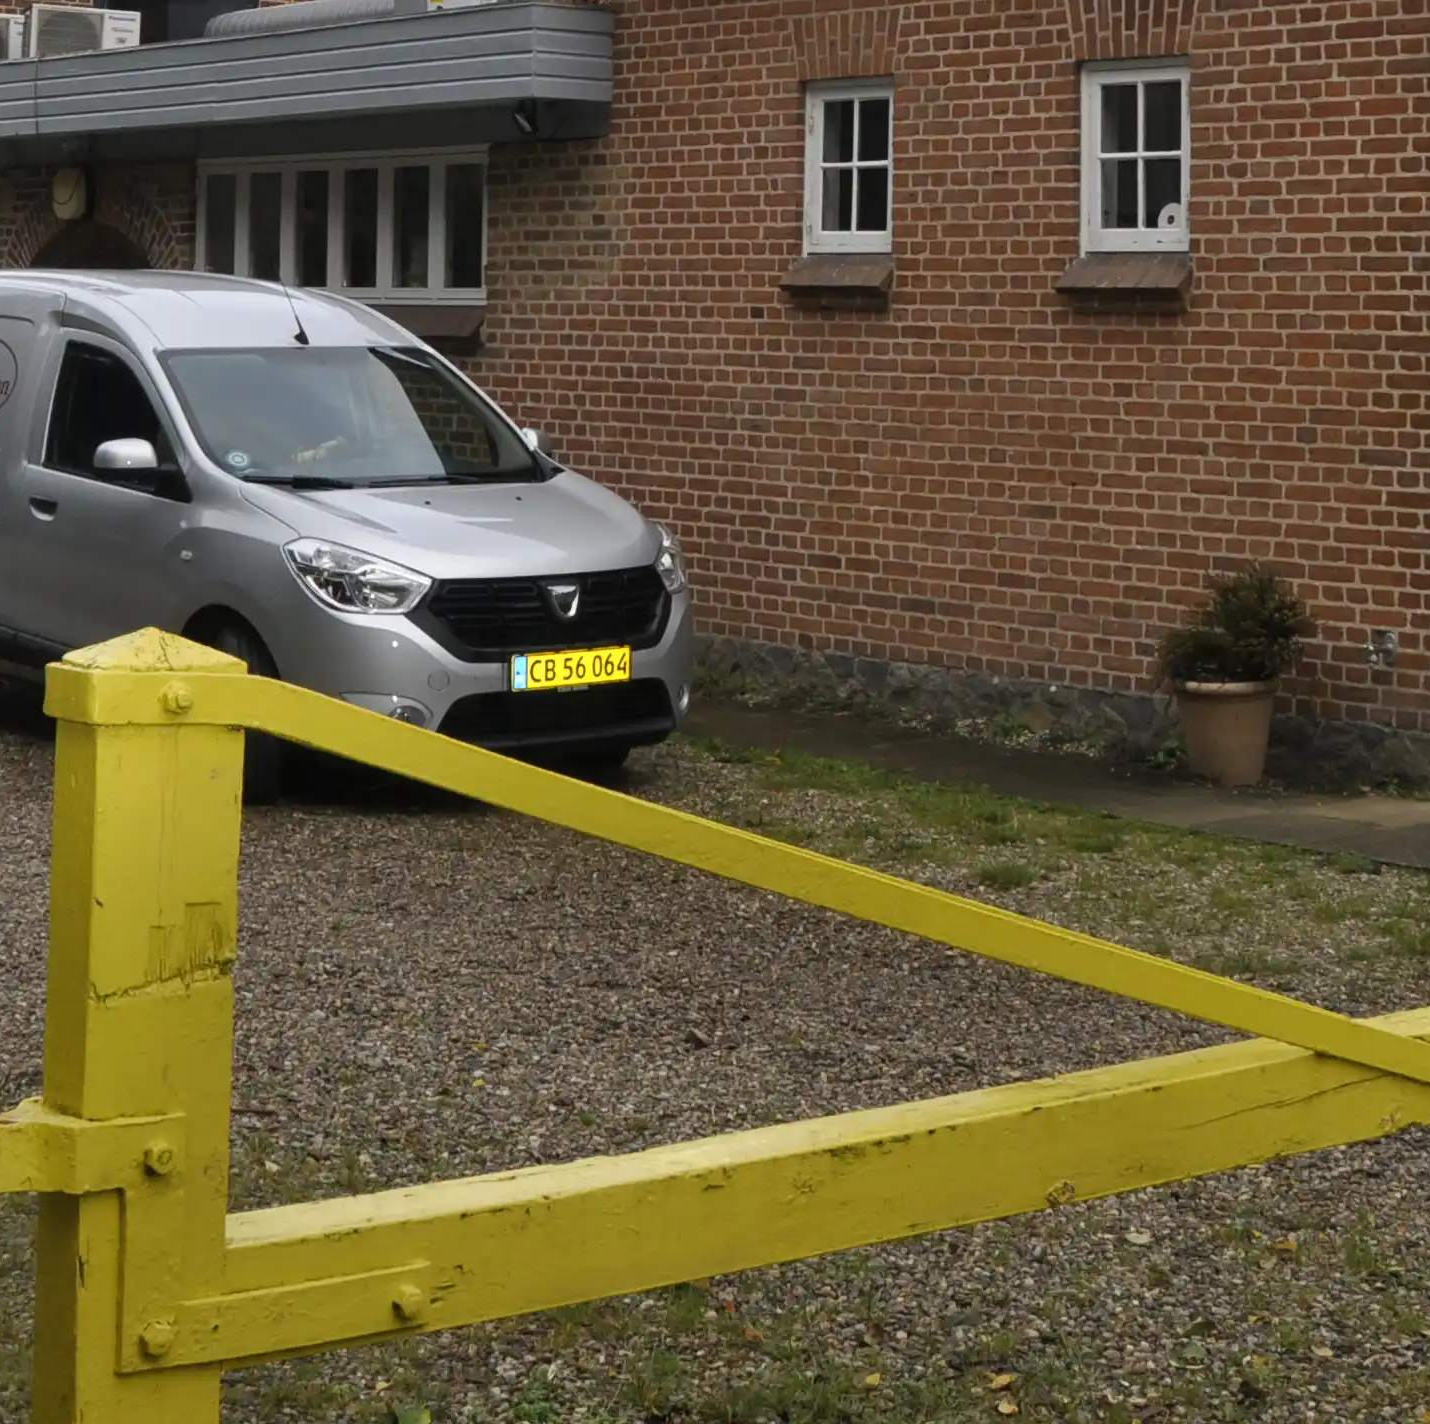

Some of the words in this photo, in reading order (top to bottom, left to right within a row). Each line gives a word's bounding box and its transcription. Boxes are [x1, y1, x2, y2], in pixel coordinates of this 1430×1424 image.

[530, 659, 556, 682] CB
[563, 656, 586, 680] 56
[592, 652, 627, 677] 064
